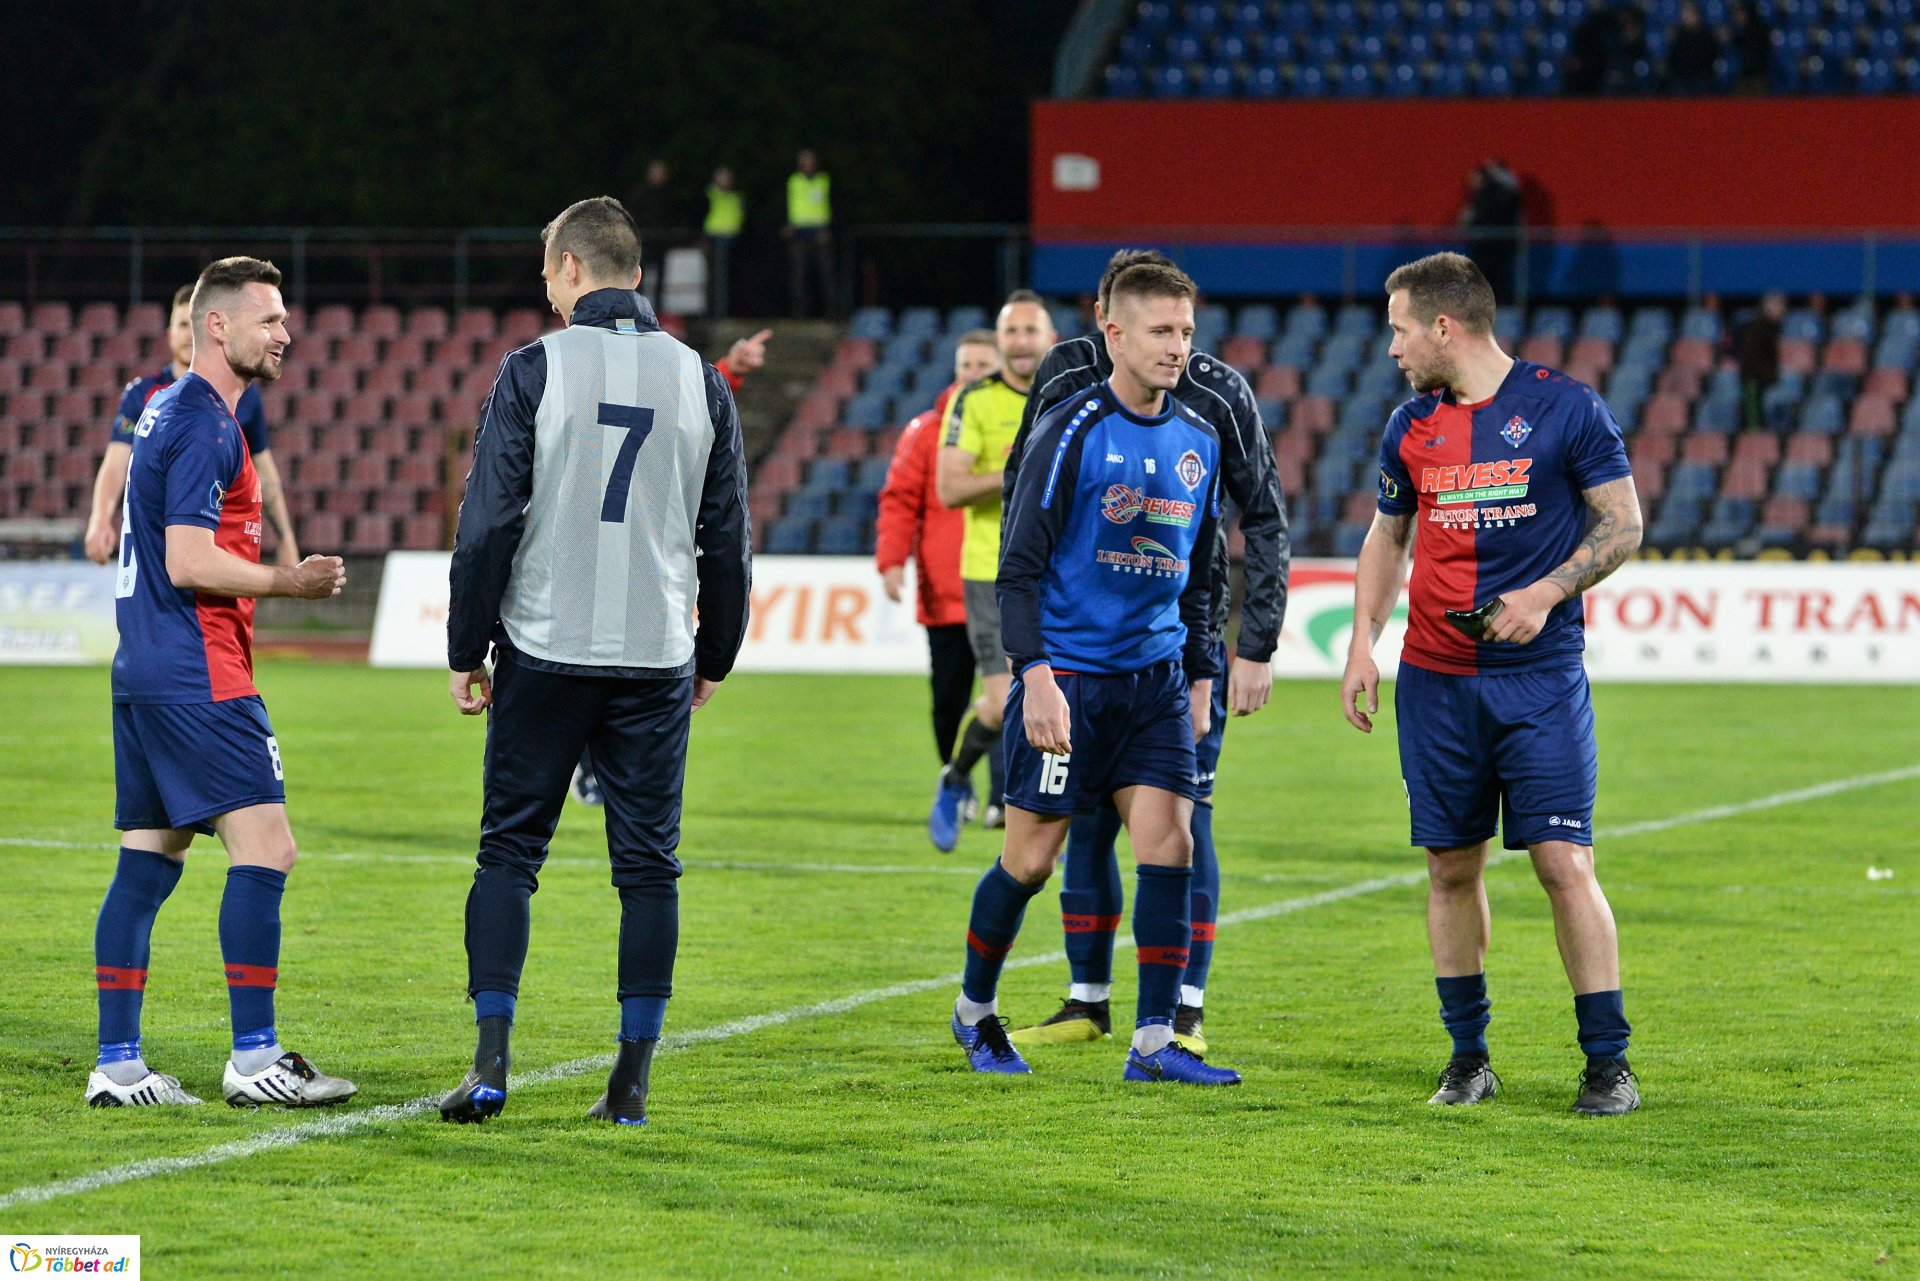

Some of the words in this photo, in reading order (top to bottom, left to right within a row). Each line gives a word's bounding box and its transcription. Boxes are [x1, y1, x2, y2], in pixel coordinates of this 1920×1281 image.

[597, 402, 654, 523] 7
[1106, 453, 1124, 463] JAKO
[1144, 458, 1156, 474] 16
[1421, 458, 1532, 493] REVESZ
[1439, 493, 1463, 501] ALWAYS
[1488, 489, 1508, 497] RIGHT
[1509, 487, 1525, 495] WAY
[1141, 497, 1196, 518] REVESZ
[1480, 503, 1537, 521] TRANS
[1096, 550, 1153, 568] LERTON
[1113, 564, 1180, 578] HUNGARY
[748, 583, 874, 644] YIR
[267, 736, 284, 781] 8
[1039, 752, 1072, 795] 16
[1561, 818, 1582, 829] JAKO
